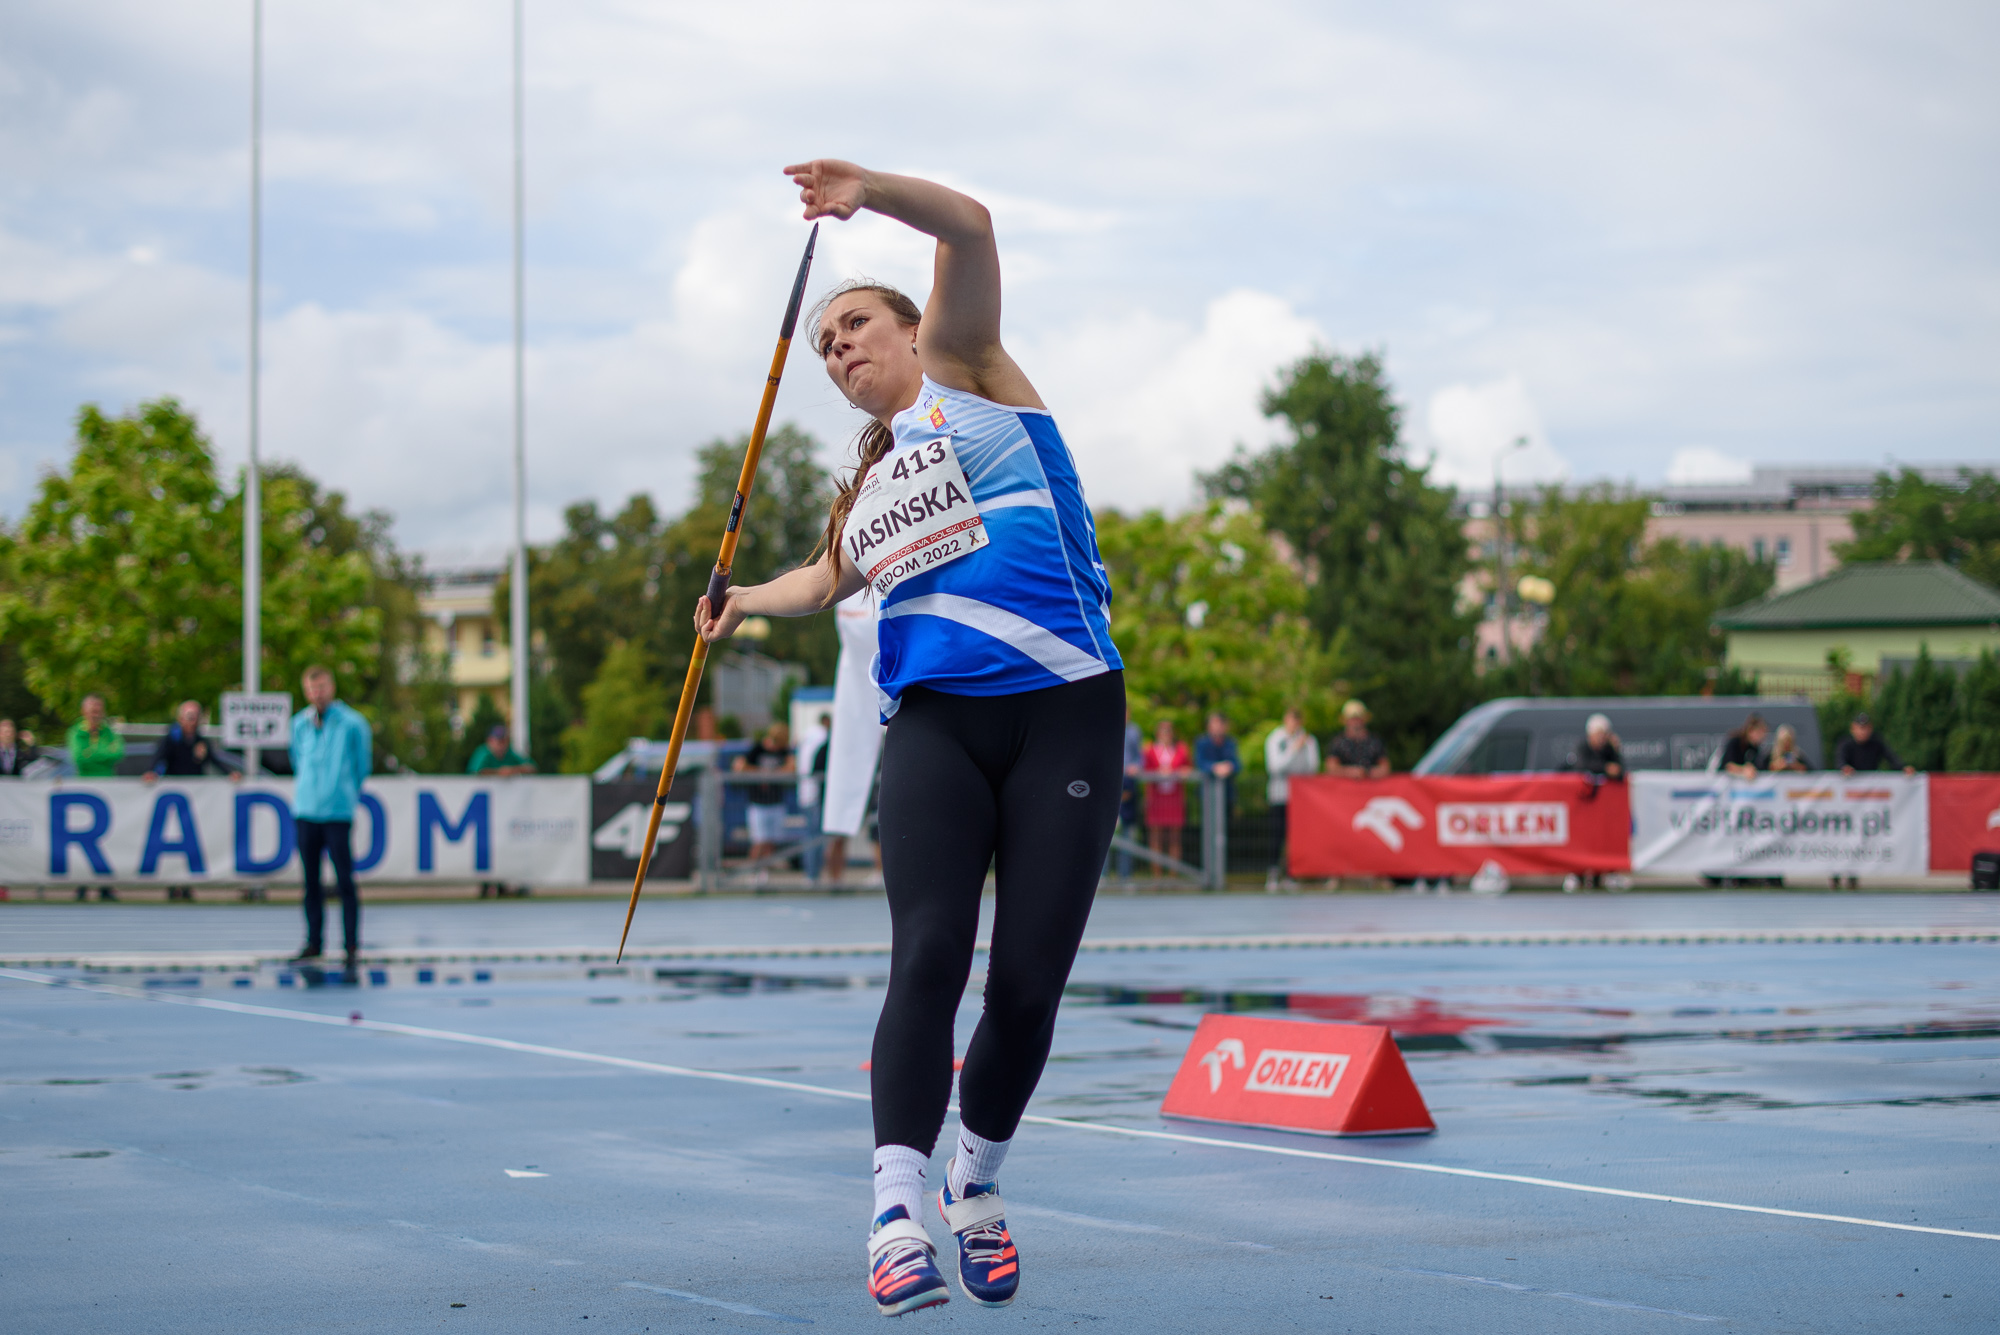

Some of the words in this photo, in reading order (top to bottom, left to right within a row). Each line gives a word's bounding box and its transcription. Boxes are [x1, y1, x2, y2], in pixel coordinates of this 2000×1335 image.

[892, 441, 946, 480] 413
[849, 480, 968, 562] JASIŃSKA
[876, 539, 930, 572] MISTRZOSTWA
[930, 525, 961, 543] POLSKI
[962, 518, 980, 530] U20
[876, 557, 922, 593] RADOM
[923, 539, 962, 565] 2022
[593, 801, 692, 860] 4F
[1449, 813, 1557, 835] ORLEN
[1255, 1056, 1342, 1091] ORLEN
